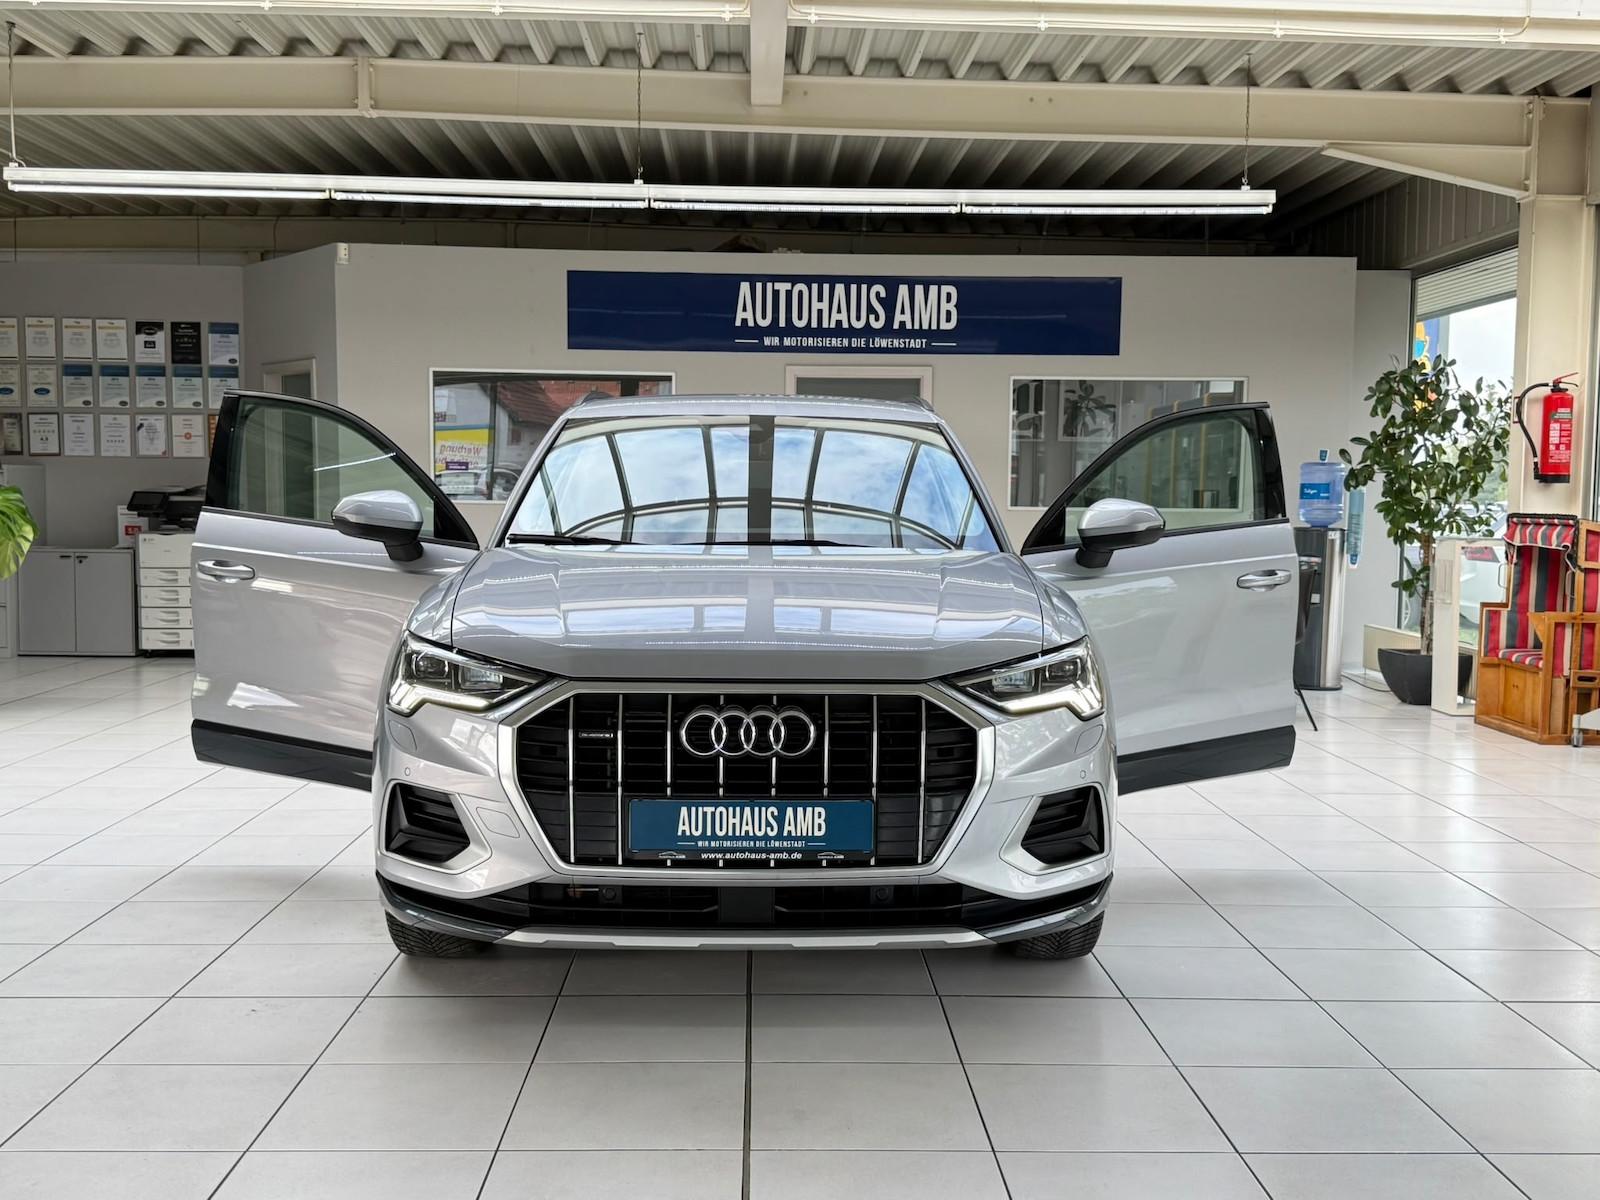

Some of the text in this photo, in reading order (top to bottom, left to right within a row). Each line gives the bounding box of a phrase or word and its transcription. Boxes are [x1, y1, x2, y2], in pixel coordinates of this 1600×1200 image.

[735, 282, 958, 330] AUTOHAUS AMB
[763, 336, 927, 349] WIR MOTORISIEREN DIE LÖWENSTADT
[677, 806, 826, 836] AUTOHAUS AMB
[710, 840, 754, 848] MOTORISIEREN
[767, 839, 806, 848] LÖWENSTADT
[701, 852, 803, 860] www.autohaus-amb.de
